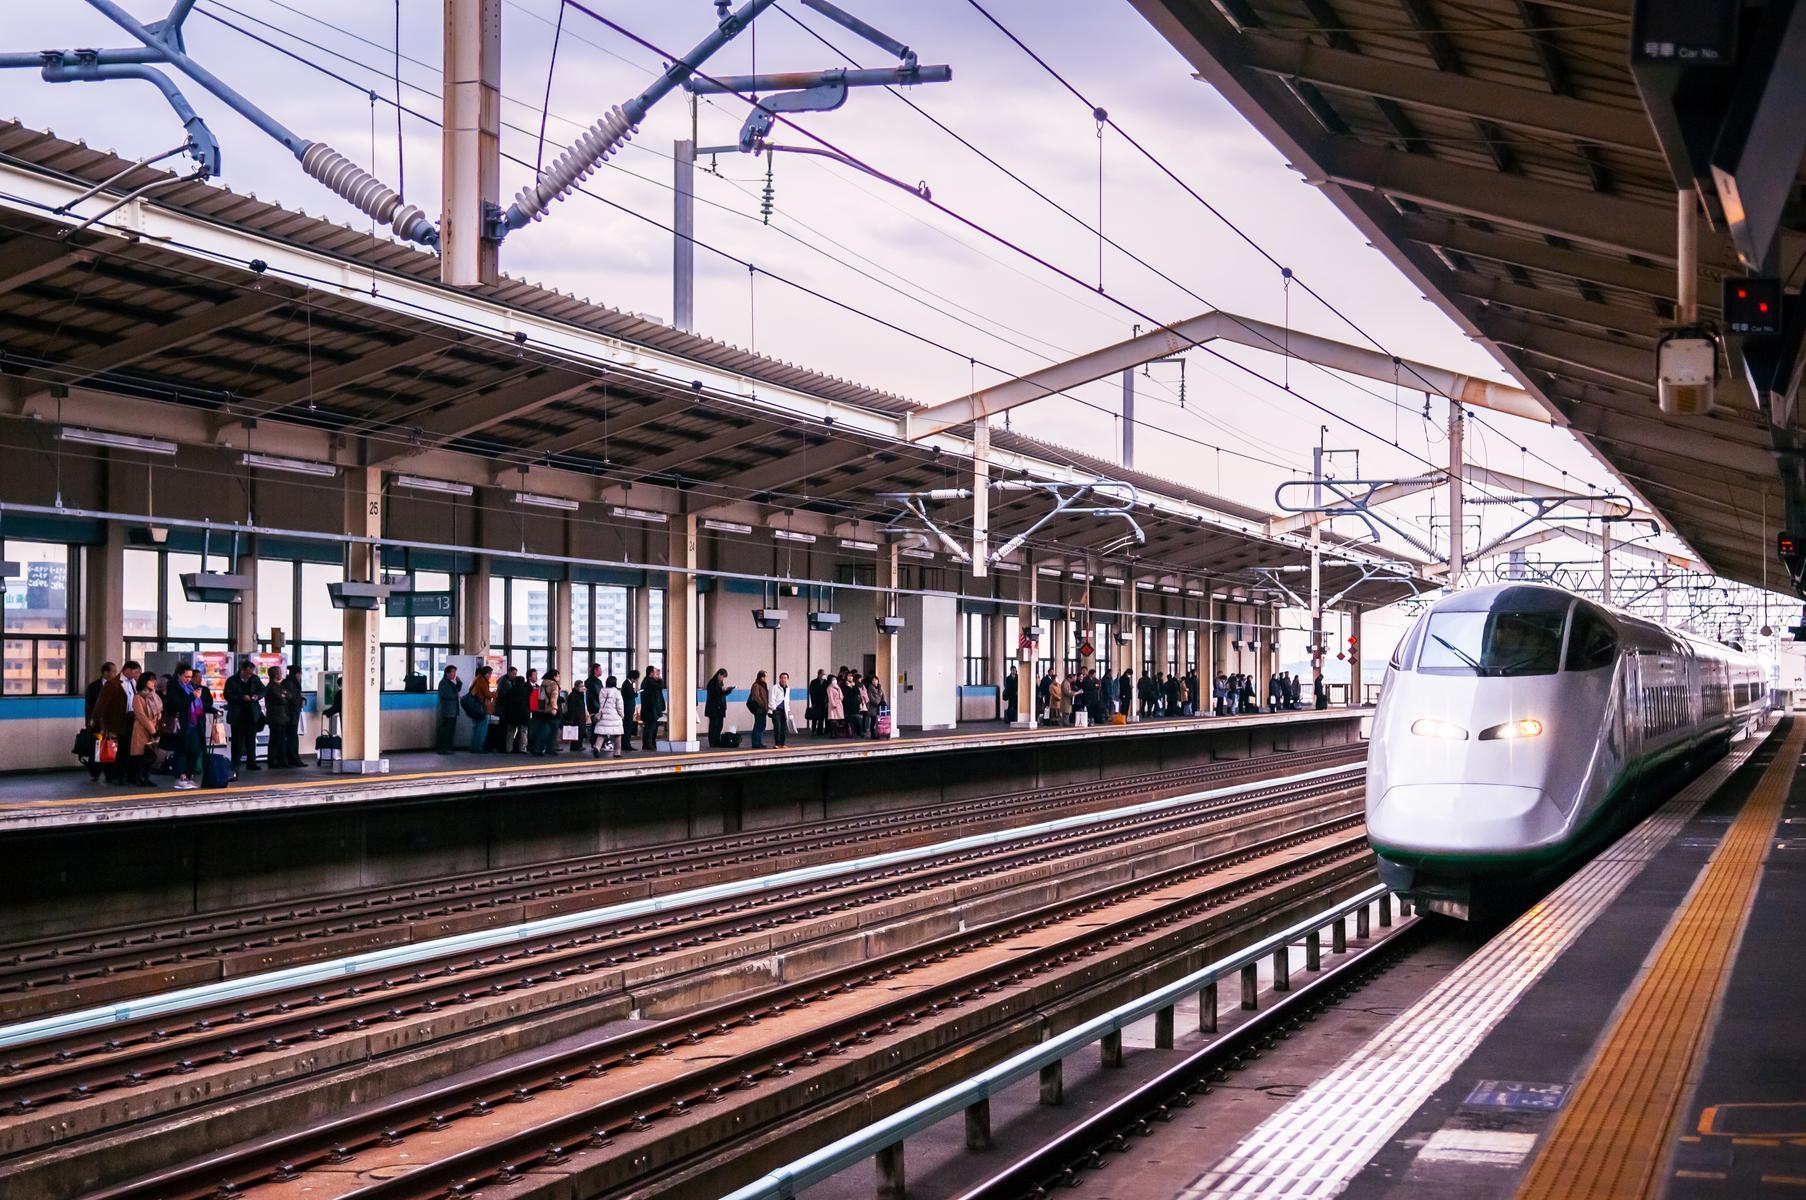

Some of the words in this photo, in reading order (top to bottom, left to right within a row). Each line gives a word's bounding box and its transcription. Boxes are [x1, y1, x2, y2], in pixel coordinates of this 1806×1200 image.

[1679, 48, 1698, 58] Car
[369, 501, 379, 515] 25
[437, 596, 450, 610] 13
